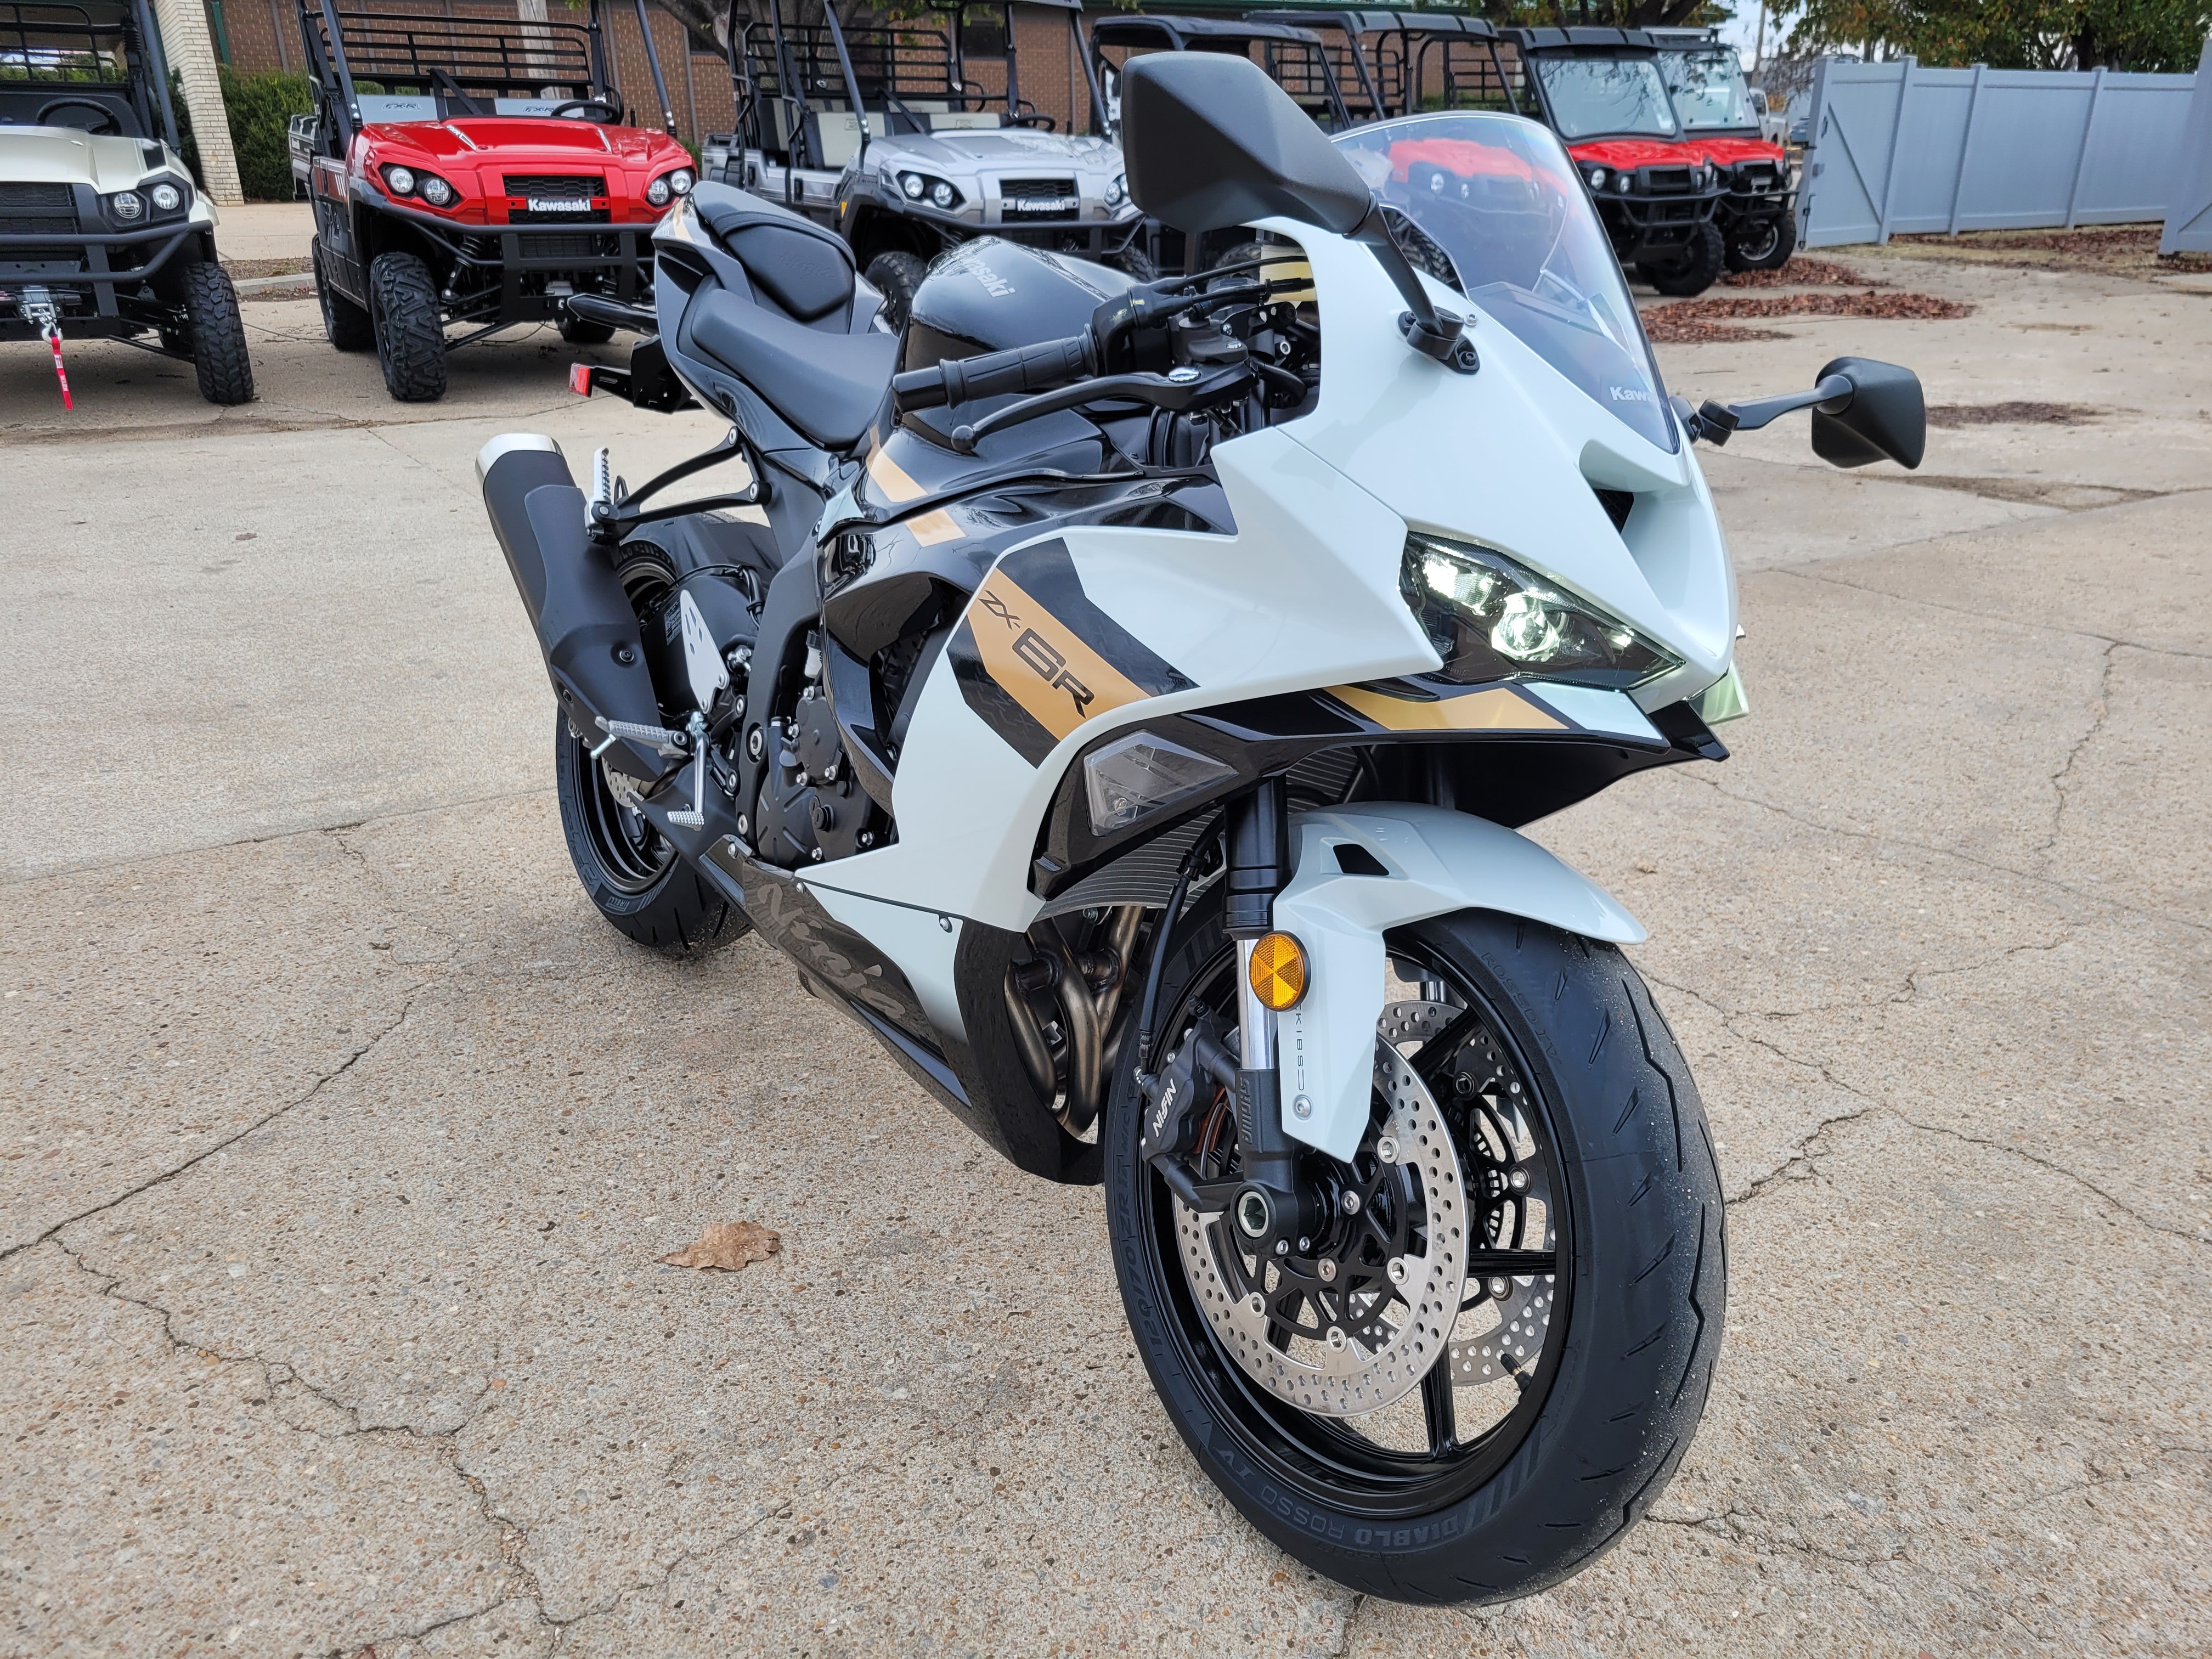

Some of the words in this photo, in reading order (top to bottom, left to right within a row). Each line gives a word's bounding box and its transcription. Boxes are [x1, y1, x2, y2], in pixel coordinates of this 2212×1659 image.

[528, 198, 591, 211] Kawasaki
[1017, 199, 1065, 211] Kawasaki
[978, 589, 1095, 720] ZX-6R
[605, 896, 630, 912] PIRELLI
[757, 883, 906, 1019] Ninja
[1481, 952, 1539, 1024] ROSSO
[1535, 1029, 1562, 1064] IV
[1153, 1077, 1177, 1138] NISSIN
[1125, 1245, 1164, 1352] 120/70
[1214, 1447, 1256, 1480] IV
[1262, 1485, 1345, 1539] ROSSO
[1355, 1514, 1459, 1547] DIABLO
